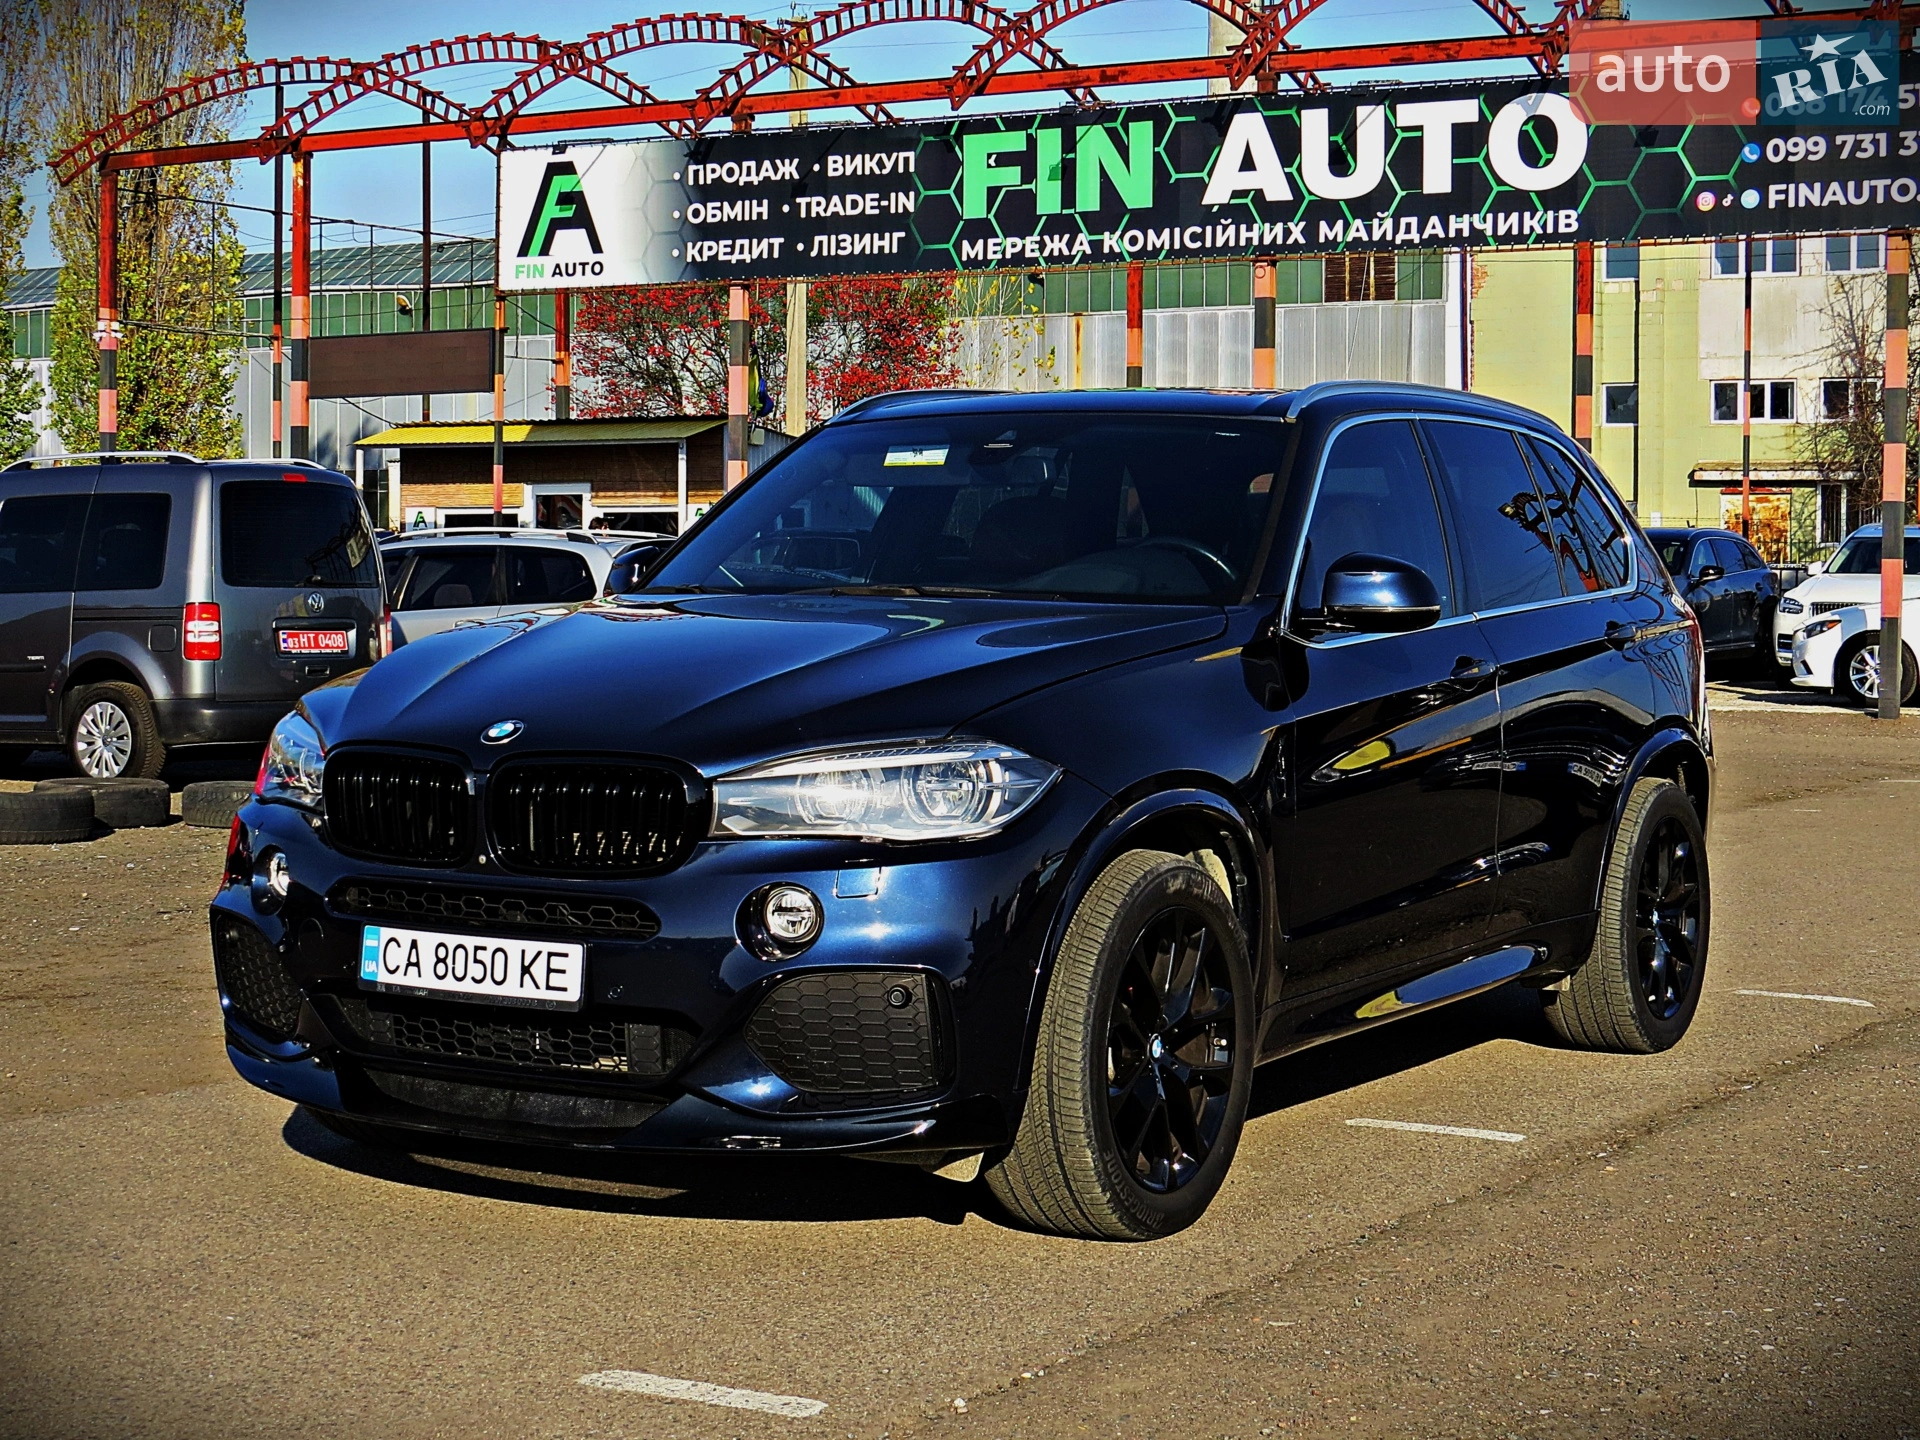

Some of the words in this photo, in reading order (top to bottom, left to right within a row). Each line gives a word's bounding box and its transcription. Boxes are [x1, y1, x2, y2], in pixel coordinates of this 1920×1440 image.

[961, 119, 1154, 220] FIN
[1201, 91, 1589, 206] AUTO
[1765, 135, 1827, 163] 099
[1835, 132, 1888, 160] 731
[687, 157, 800, 186] ПРОДАЖ
[826, 151, 916, 177] ВИКУП
[686, 198, 769, 225] ОБМІН
[795, 190, 916, 219] TRADE-IN
[686, 237, 785, 264] КРЕДИТ
[810, 231, 906, 258] ЛІЗИНГ
[961, 233, 1092, 262] МЕРЕЖА
[1102, 217, 1306, 255] КОМІСІЙНИХ
[1318, 209, 1580, 246] МАЙДАНЧИКІВ
[515, 263, 545, 279] FIN
[551, 260, 604, 278] AUTO
[299, 633, 316, 648] HT
[318, 633, 344, 648] 0408
[383, 936, 422, 979] CA
[433, 942, 509, 986] 8050
[519, 948, 569, 992] KE
